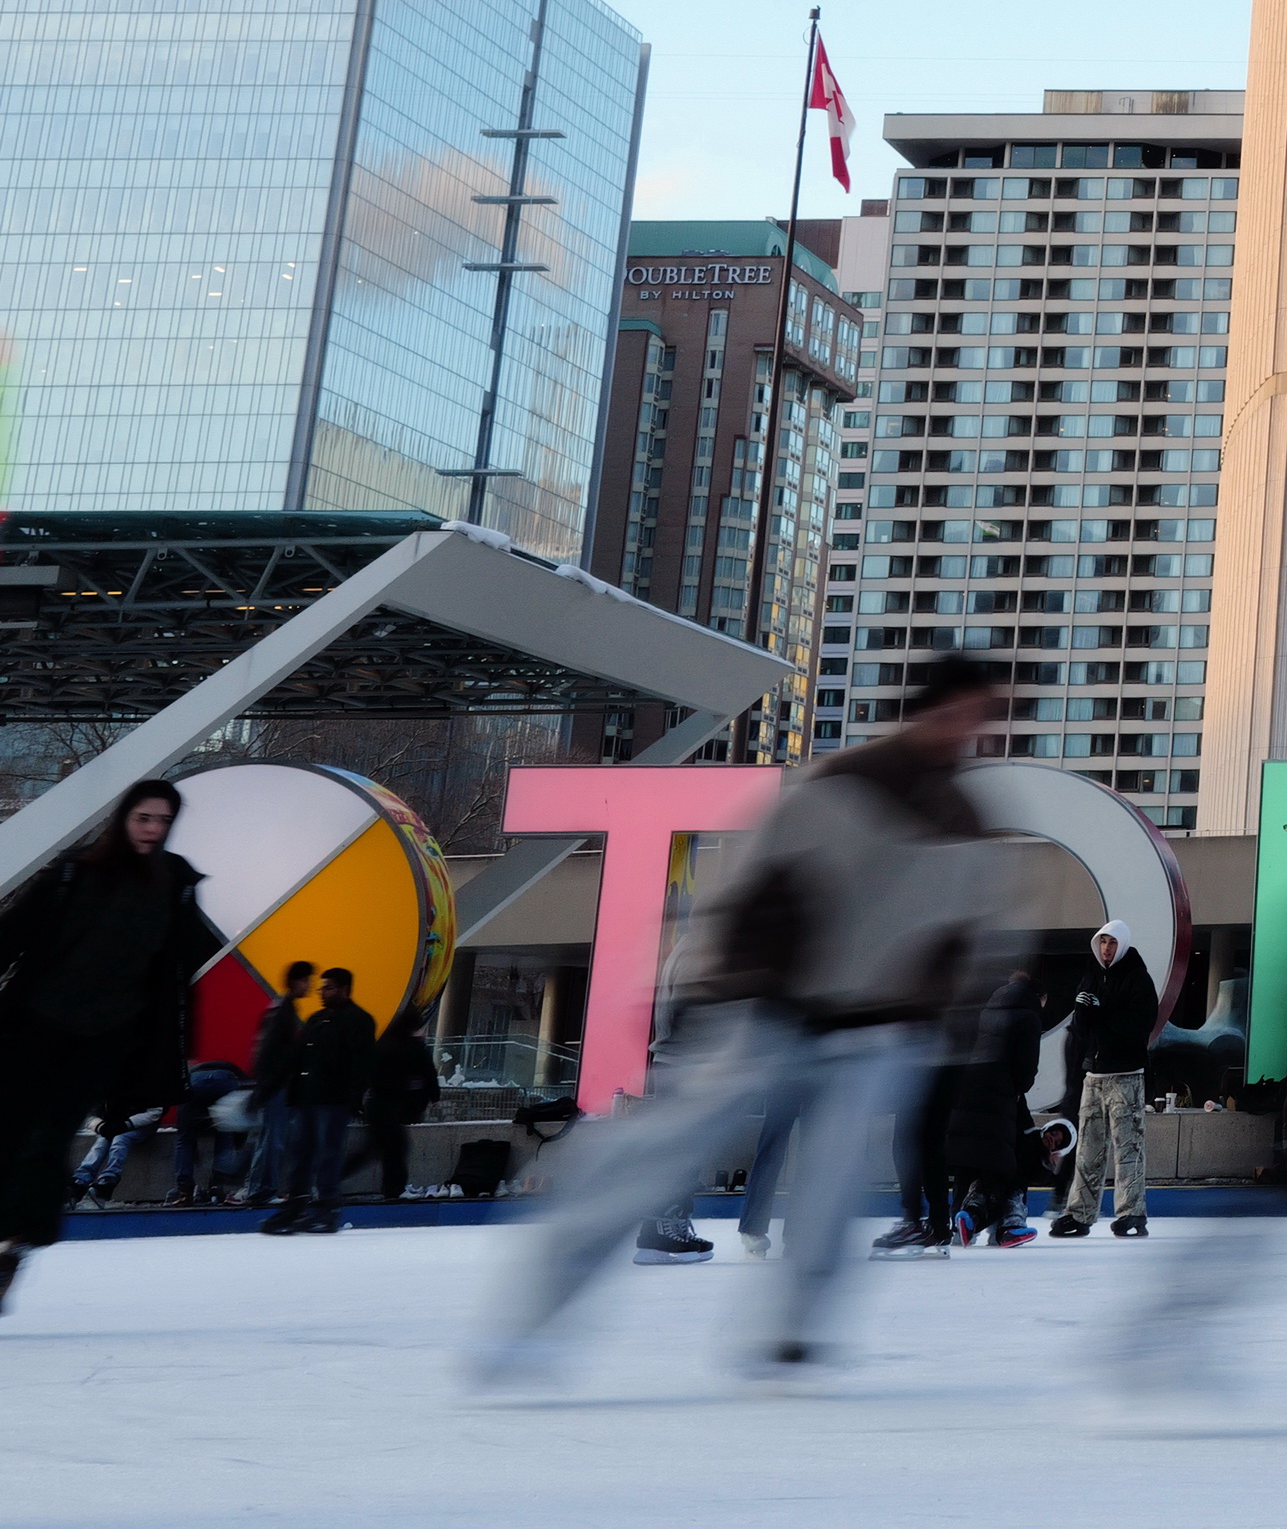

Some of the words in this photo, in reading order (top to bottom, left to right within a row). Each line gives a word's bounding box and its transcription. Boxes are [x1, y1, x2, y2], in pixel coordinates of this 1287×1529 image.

[624, 264, 771, 284] OUBLETREE
[640, 290, 661, 300] BY
[672, 290, 735, 300] HILTON
